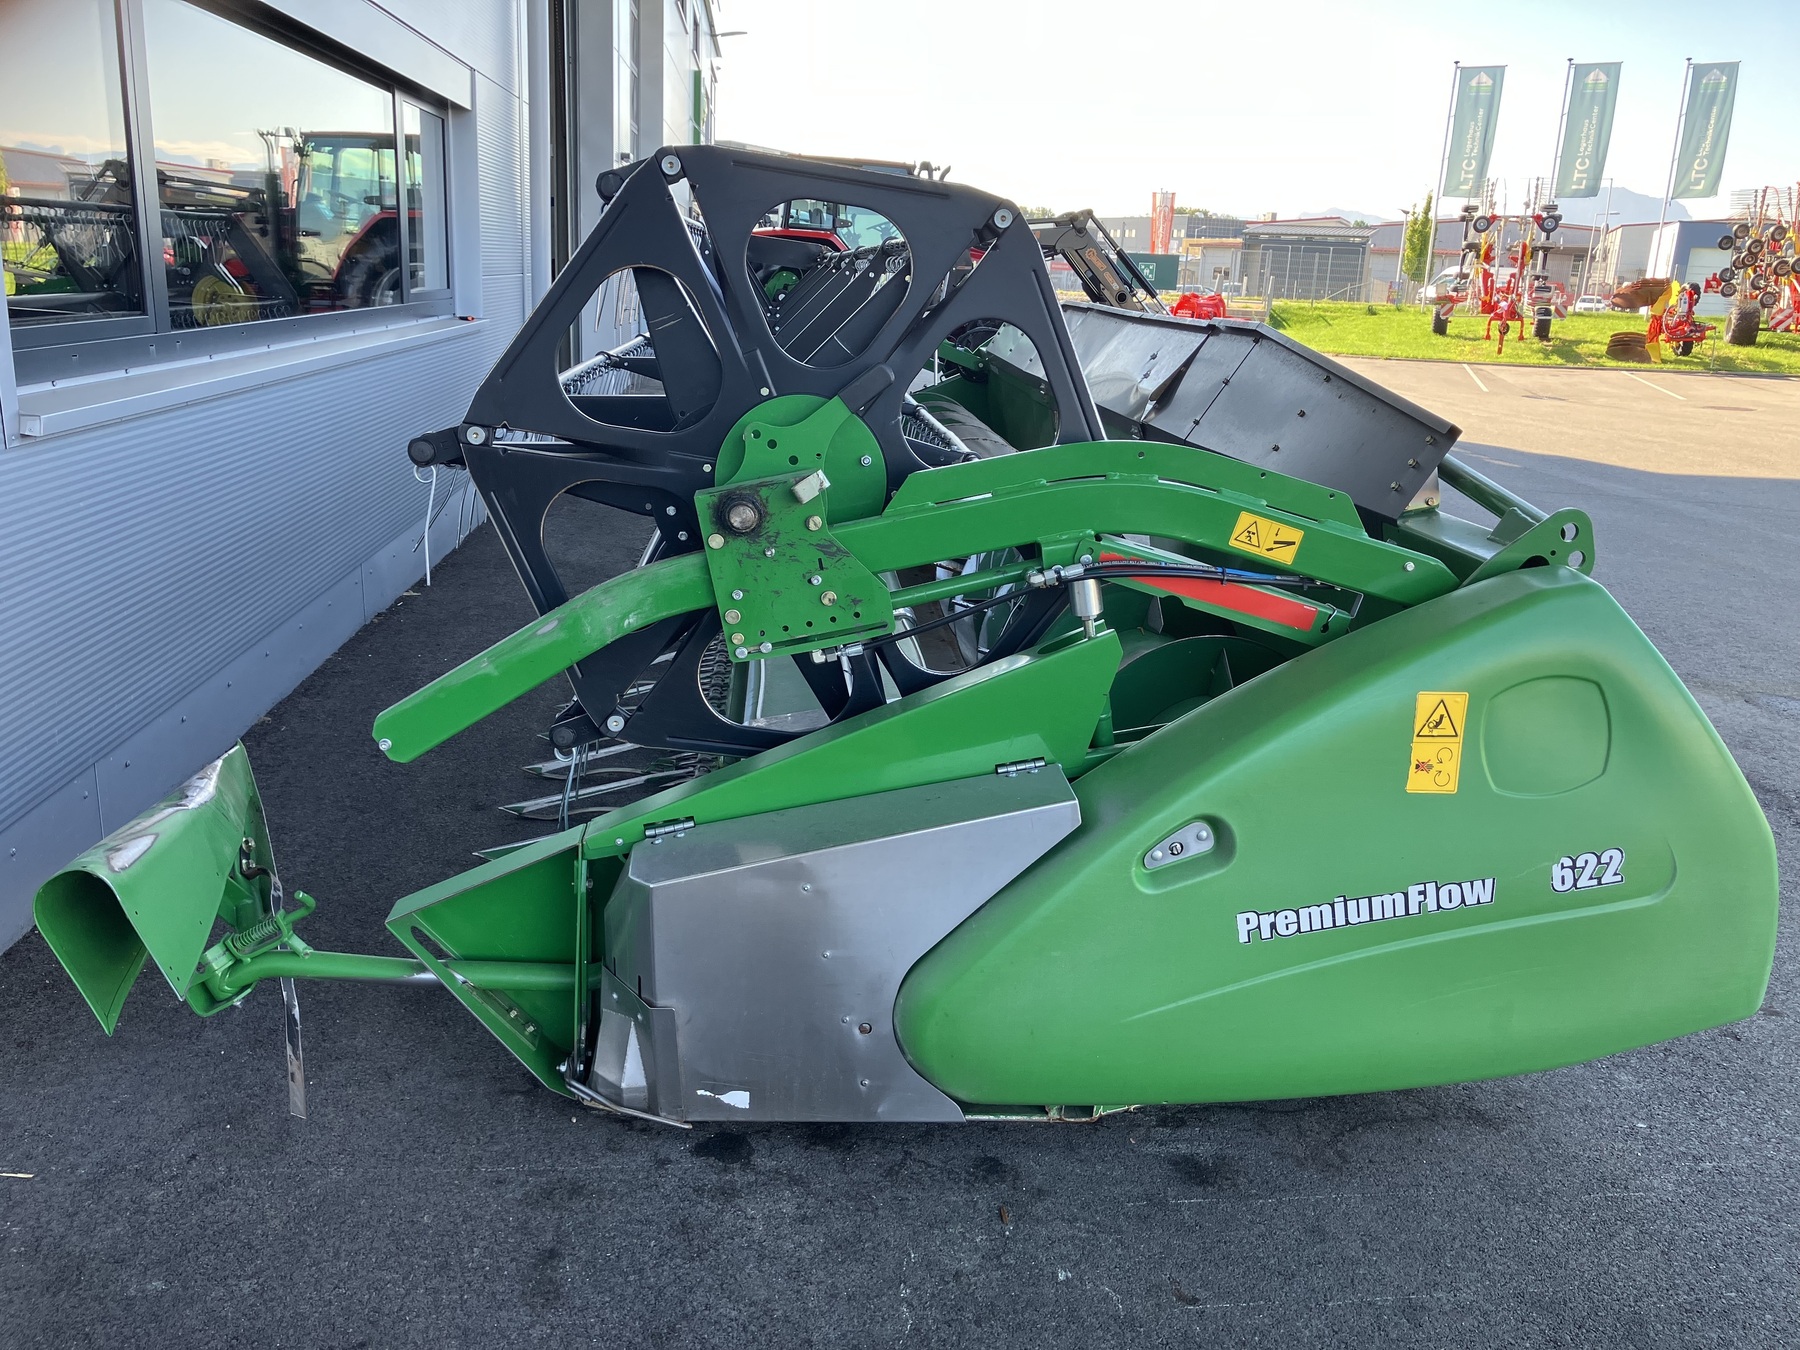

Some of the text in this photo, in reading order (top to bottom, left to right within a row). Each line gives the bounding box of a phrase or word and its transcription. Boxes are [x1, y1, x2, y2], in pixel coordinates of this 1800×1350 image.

[1464, 122, 1475, 157] Lagerhaus
[1578, 120, 1589, 156] Lagerhaus
[1459, 159, 1476, 190] LTC
[1571, 157, 1590, 190] LTC
[1690, 158, 1708, 190] LTC
[1552, 846, 1625, 893] 622
[1236, 877, 1497, 944] PremiumFlow
